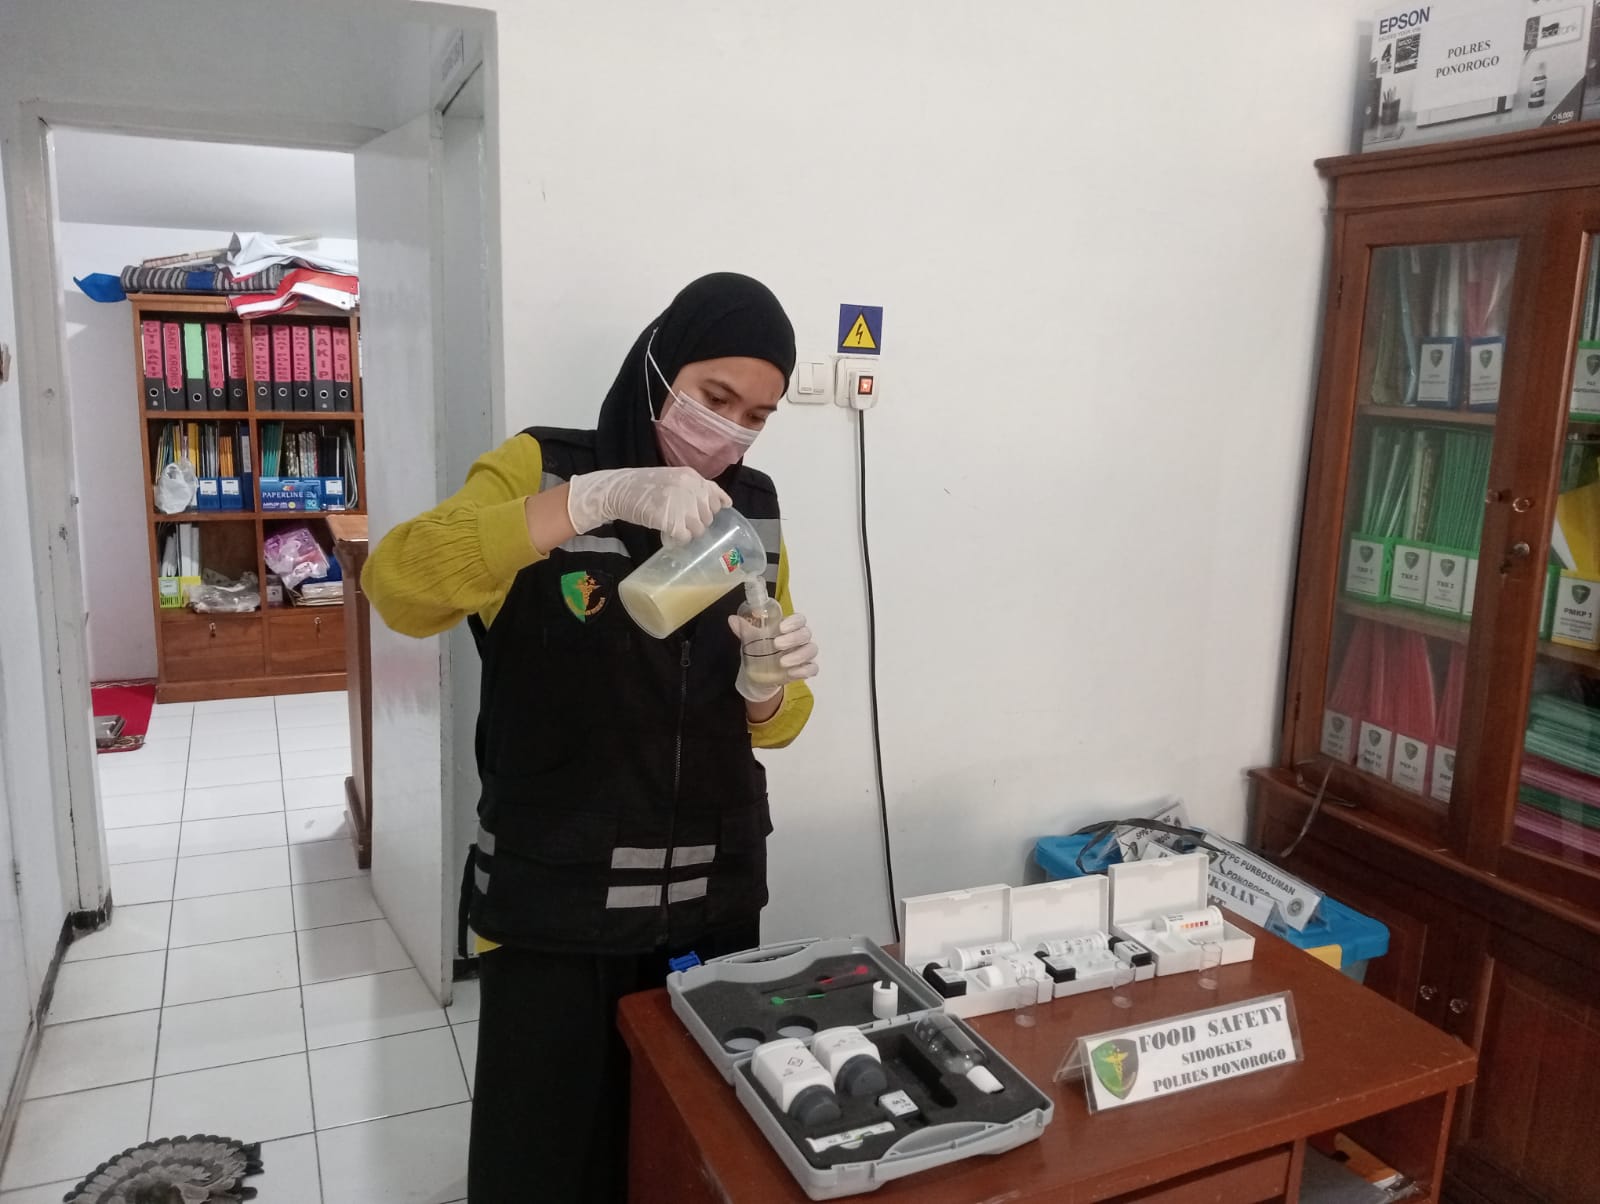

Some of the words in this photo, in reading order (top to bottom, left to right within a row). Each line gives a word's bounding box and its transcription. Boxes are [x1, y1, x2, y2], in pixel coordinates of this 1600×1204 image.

[1379, 6, 1430, 35] EPSON
[1447, 39, 1491, 58] POLRES
[1435, 55, 1500, 78] PONOROGO
[316, 327, 329, 379] LAKIP
[336, 353, 350, 381] SIM
[262, 491, 304, 499] PAPERLINE
[1240, 860, 1297, 896] PURBOSUMAN
[1138, 1025, 1196, 1053] FOOD
[1207, 1004, 1282, 1037] SAFETY
[1181, 1037, 1252, 1065] SIDOKKES
[1153, 1067, 1209, 1092] POLRES
[1212, 1048, 1286, 1077] PONOROGO
